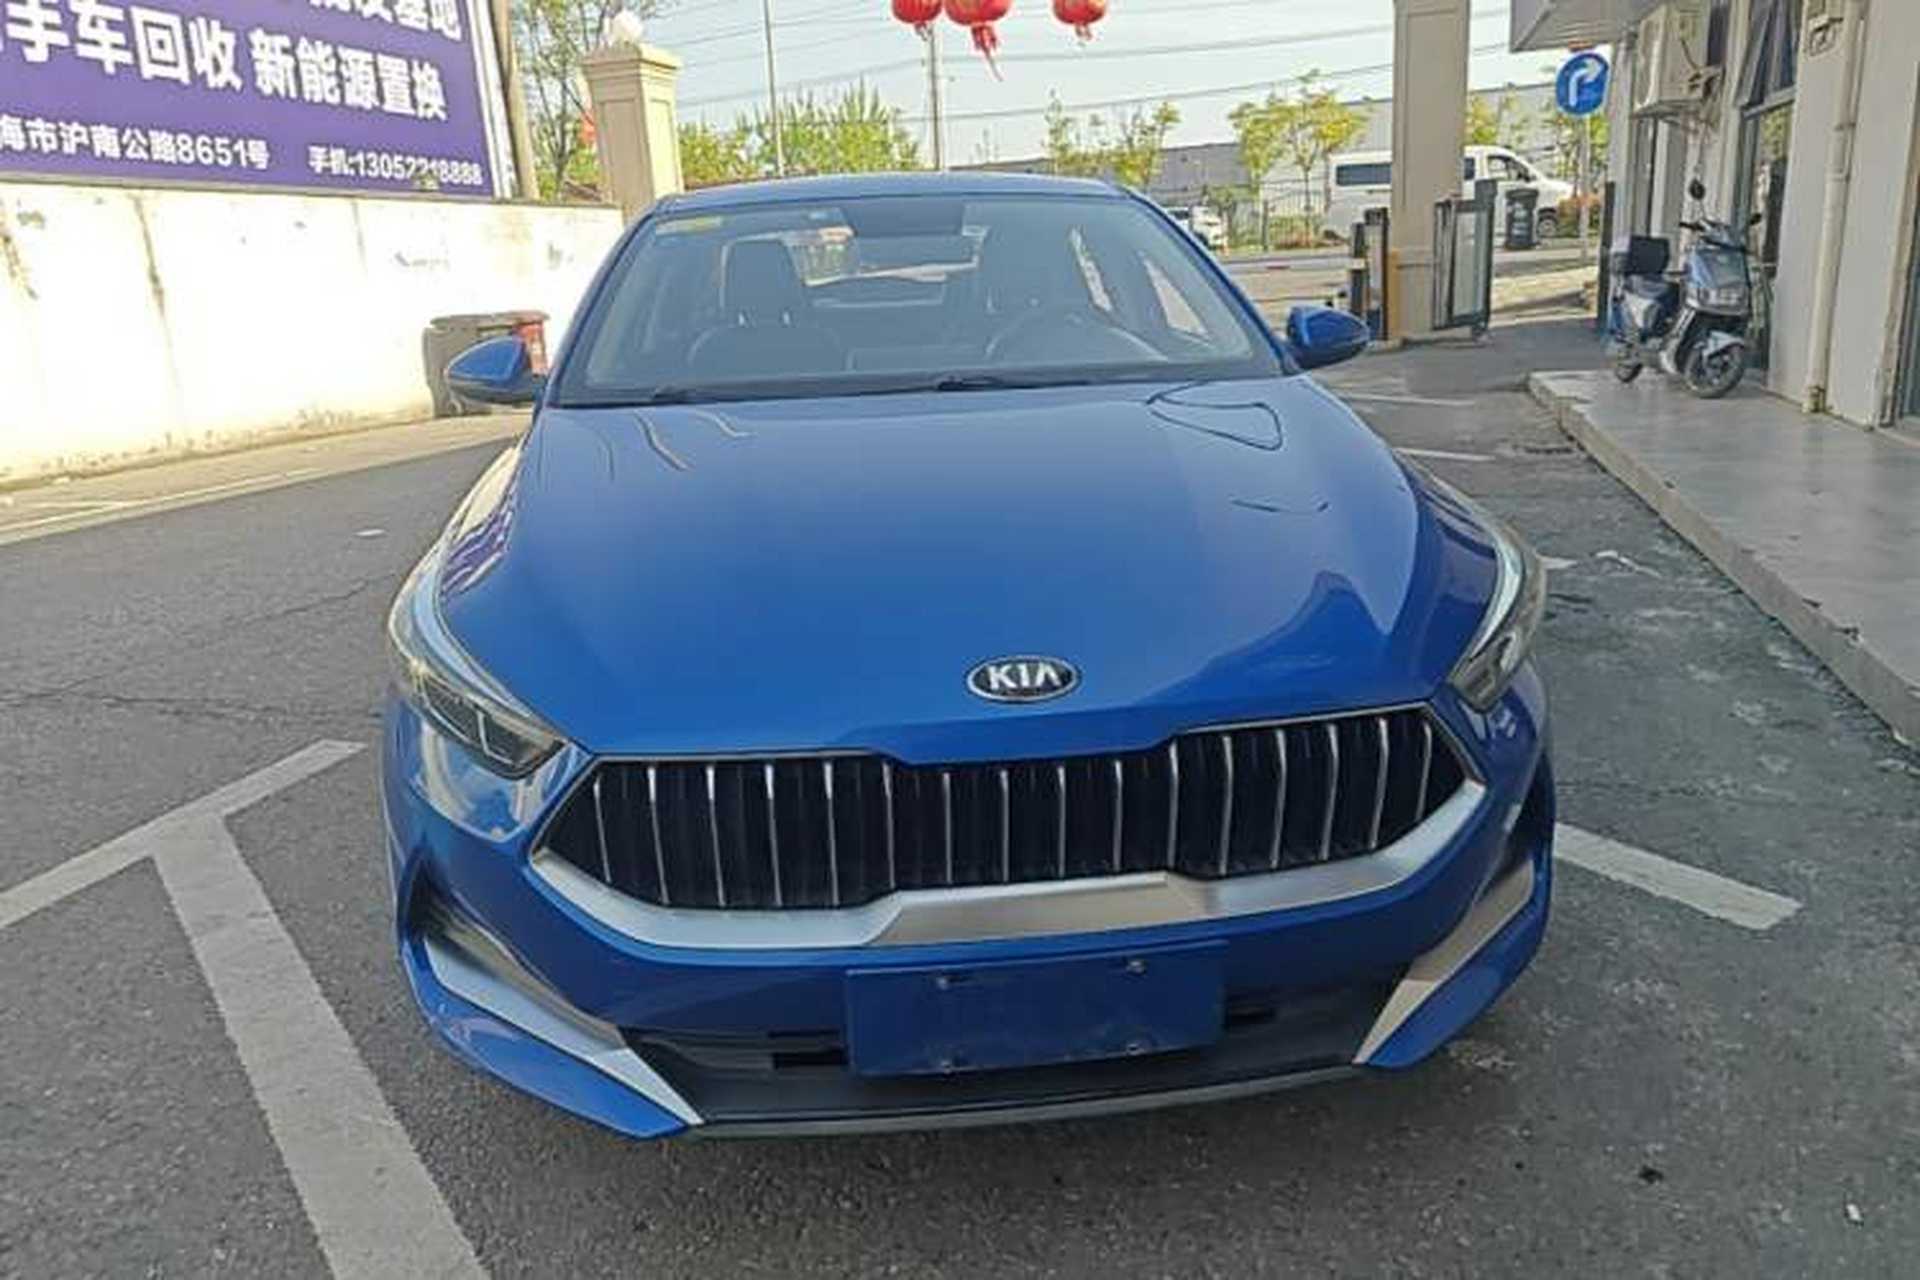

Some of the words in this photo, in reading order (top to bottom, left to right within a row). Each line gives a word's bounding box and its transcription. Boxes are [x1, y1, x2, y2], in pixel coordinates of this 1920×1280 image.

[310, 0, 462, 41] 基地
[0, 0, 242, 91] 手车回收
[252, 28, 447, 119] 新能源置换
[988, 662, 1062, 690] KIA
